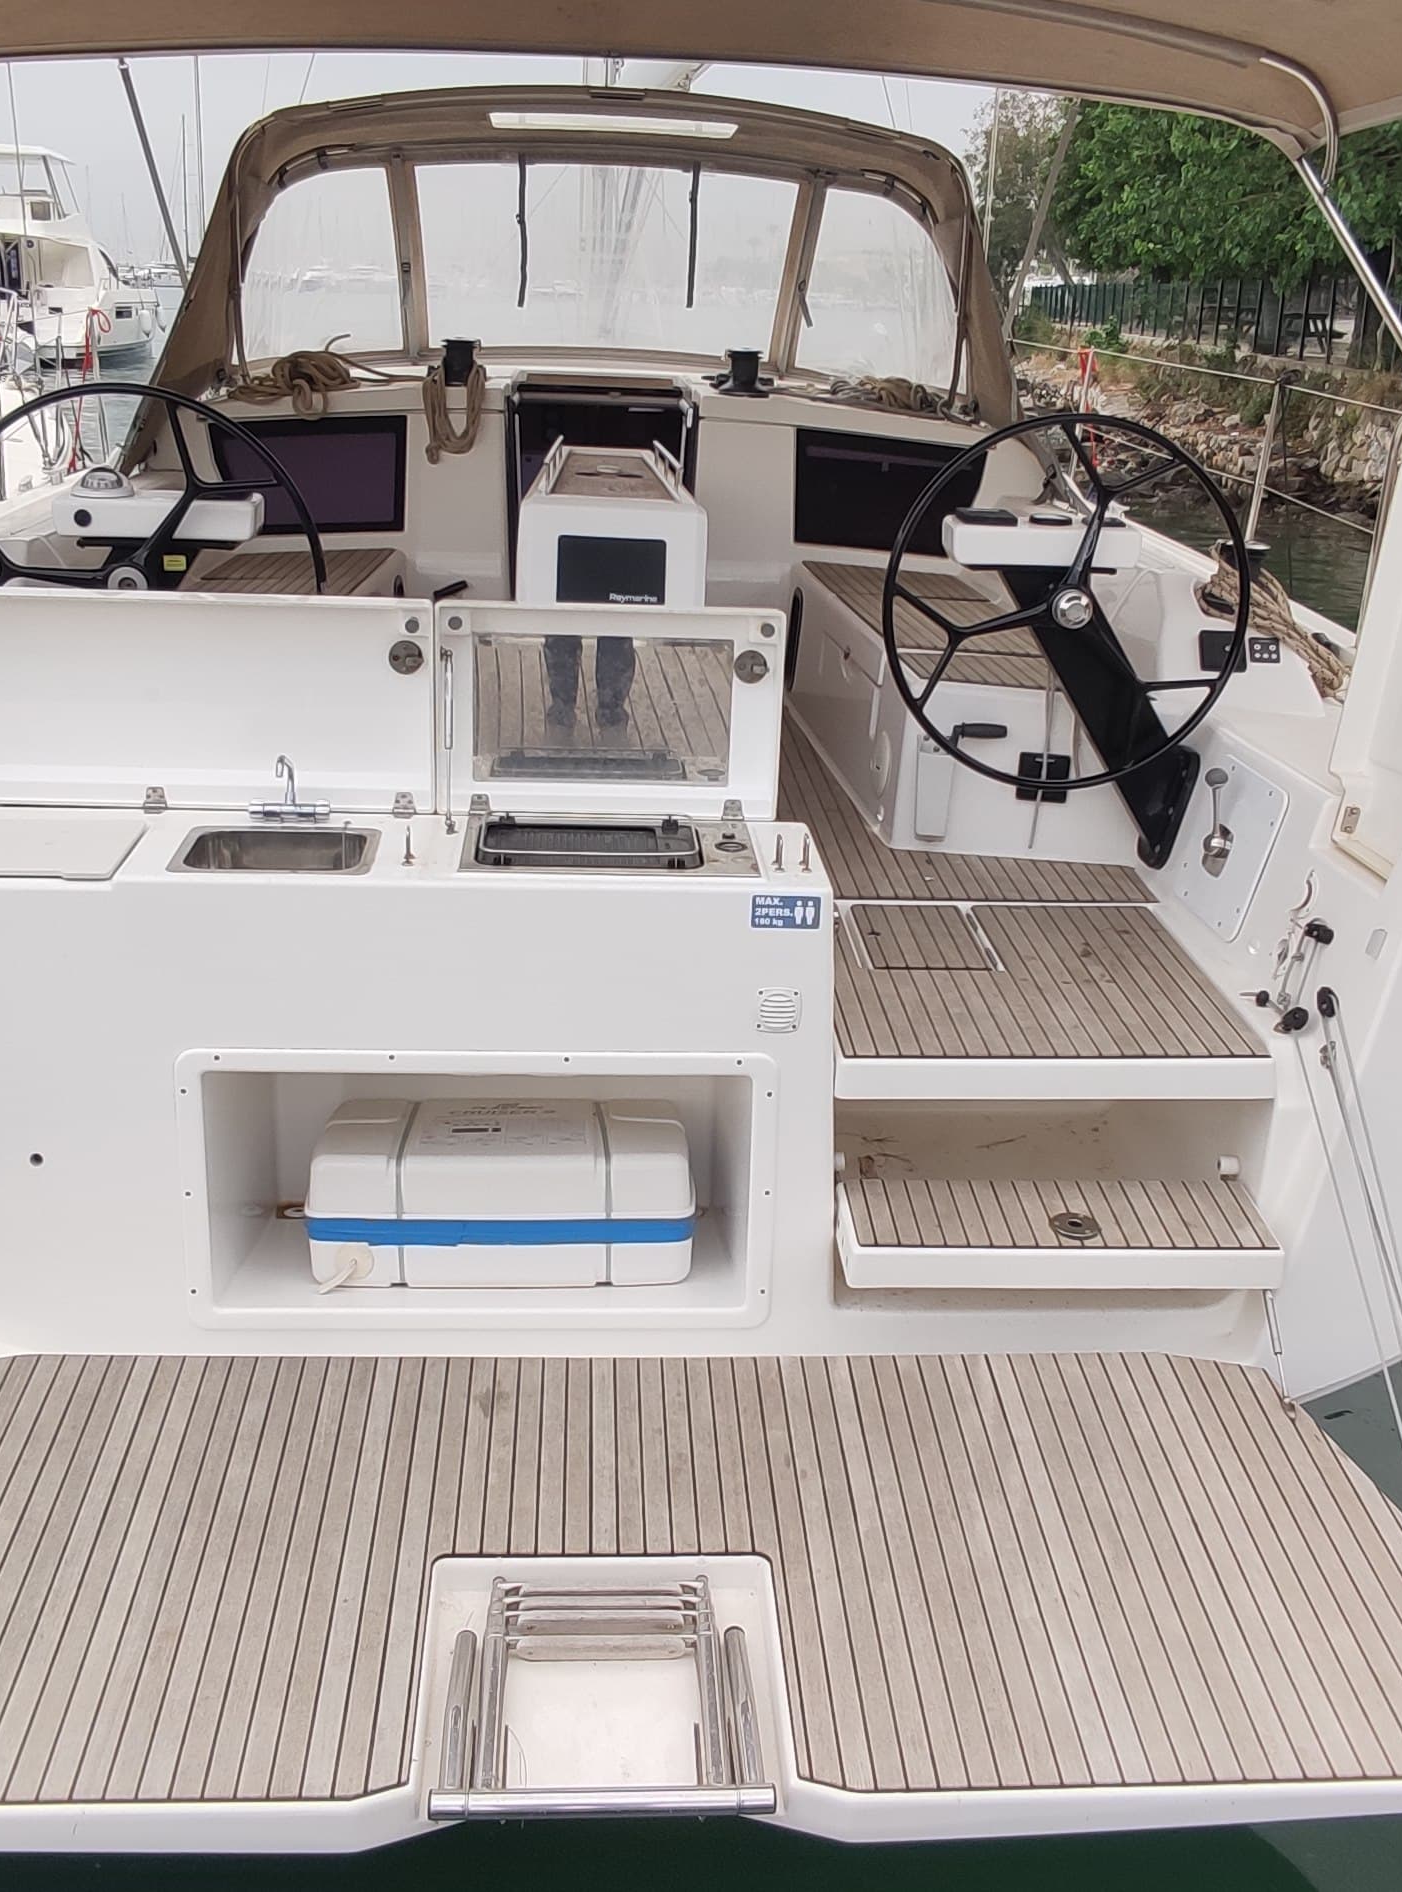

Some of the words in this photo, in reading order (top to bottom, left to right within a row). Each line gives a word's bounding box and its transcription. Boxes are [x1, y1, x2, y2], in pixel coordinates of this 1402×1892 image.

[609, 592, 658, 603] Raymarine
[755, 896, 784, 906] MAX.
[754, 907, 793, 917] 2PERS.
